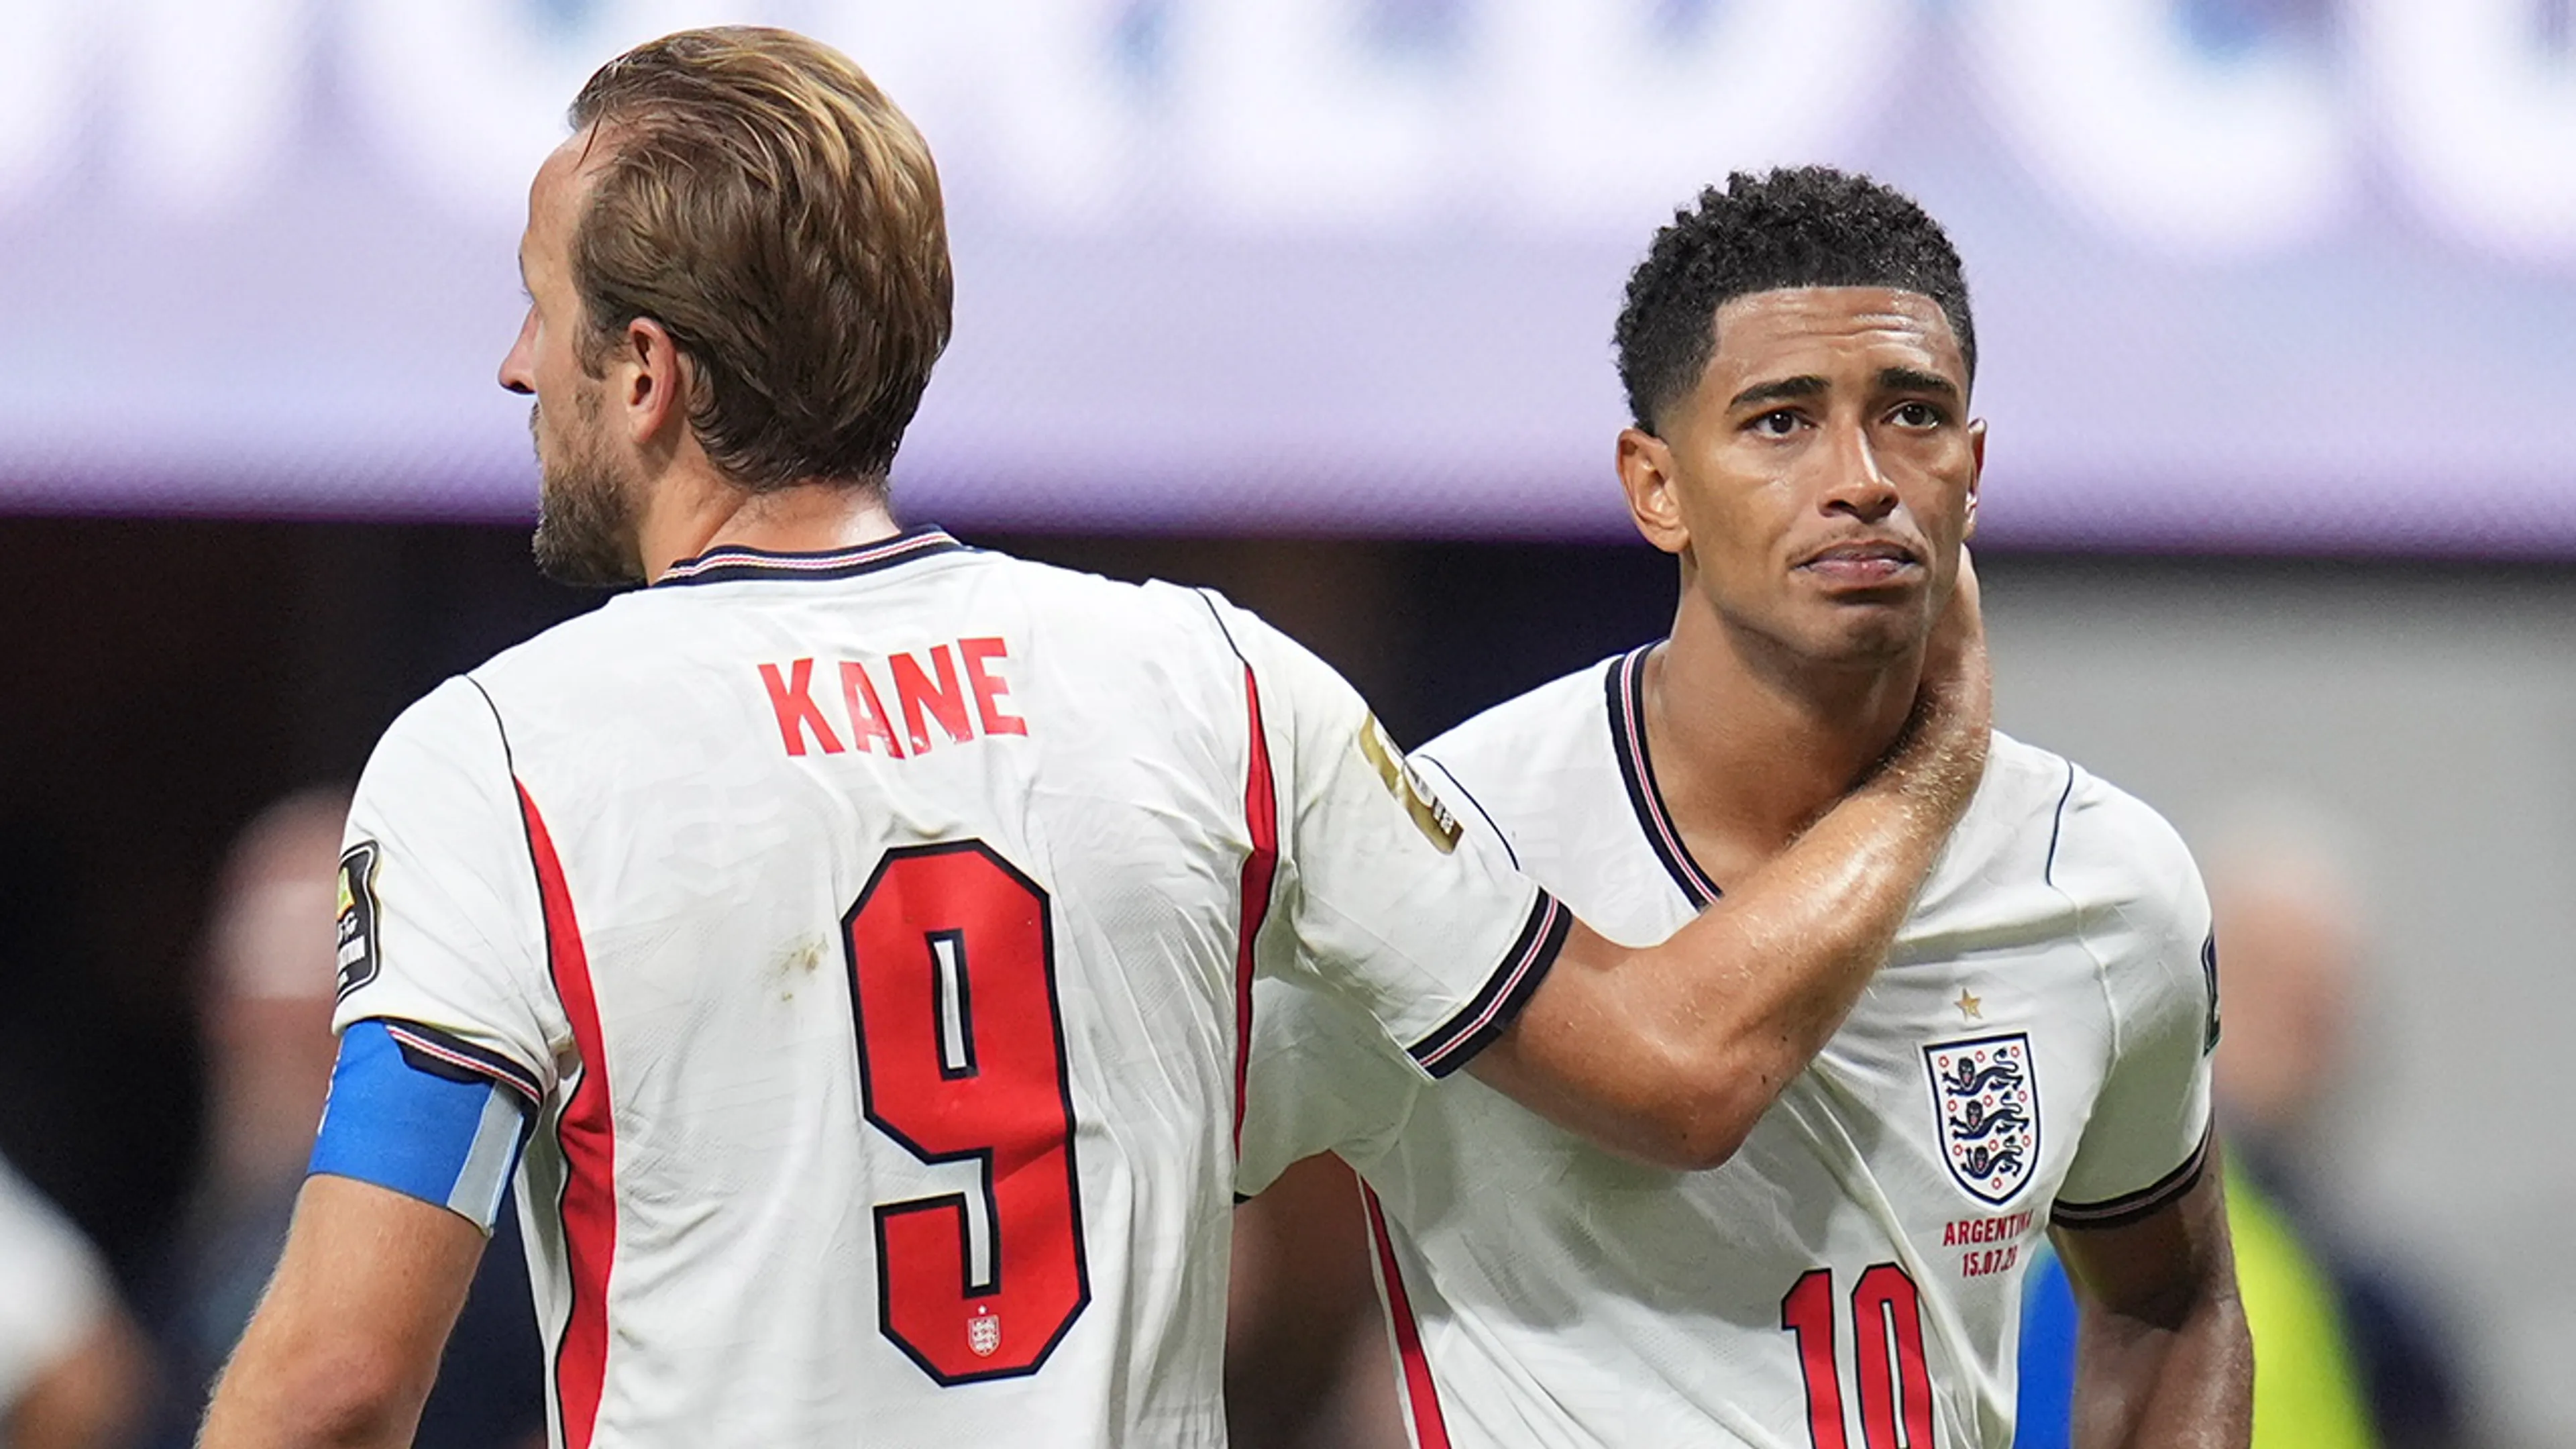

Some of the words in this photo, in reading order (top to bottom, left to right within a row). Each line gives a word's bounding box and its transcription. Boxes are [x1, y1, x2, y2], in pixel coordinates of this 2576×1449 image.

[757, 637, 1028, 759] KANE
[841, 837, 1091, 1387] 9
[1781, 1261, 1935, 1449] 10
